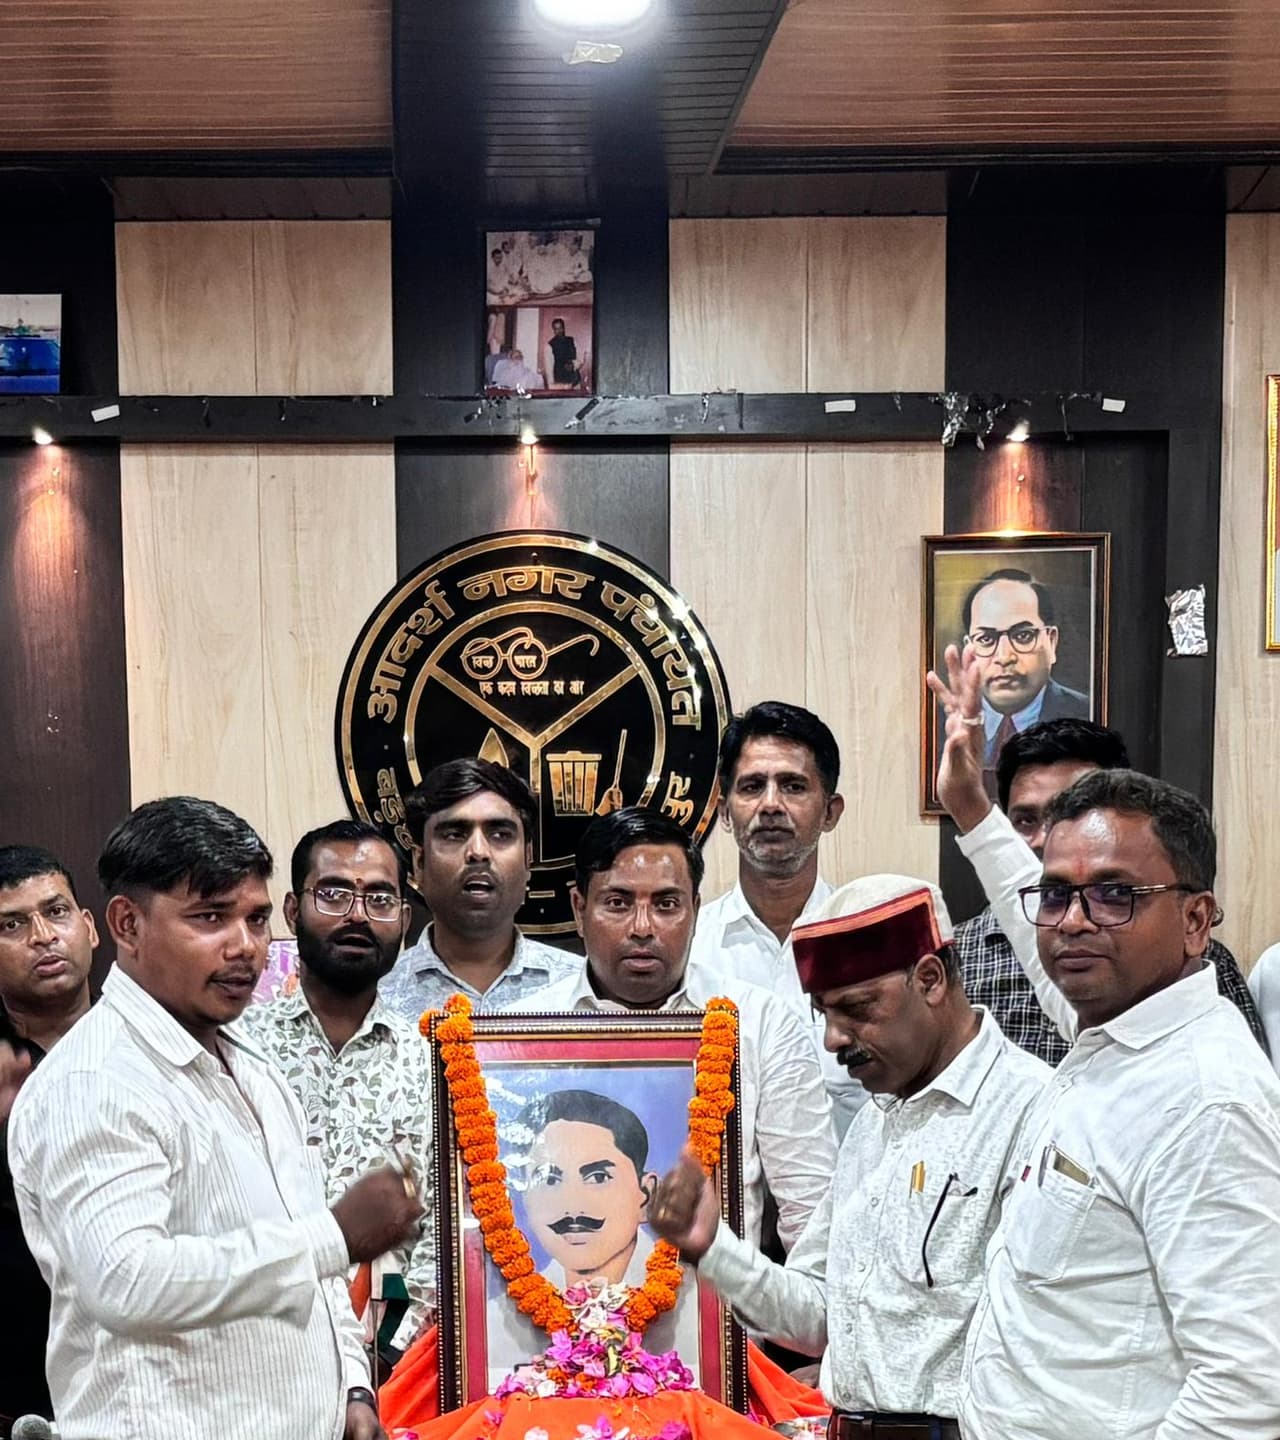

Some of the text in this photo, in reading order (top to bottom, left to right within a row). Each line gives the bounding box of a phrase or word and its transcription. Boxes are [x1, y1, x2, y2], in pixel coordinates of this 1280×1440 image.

[367, 565, 702, 731] आदर्श नगर पंचायत
